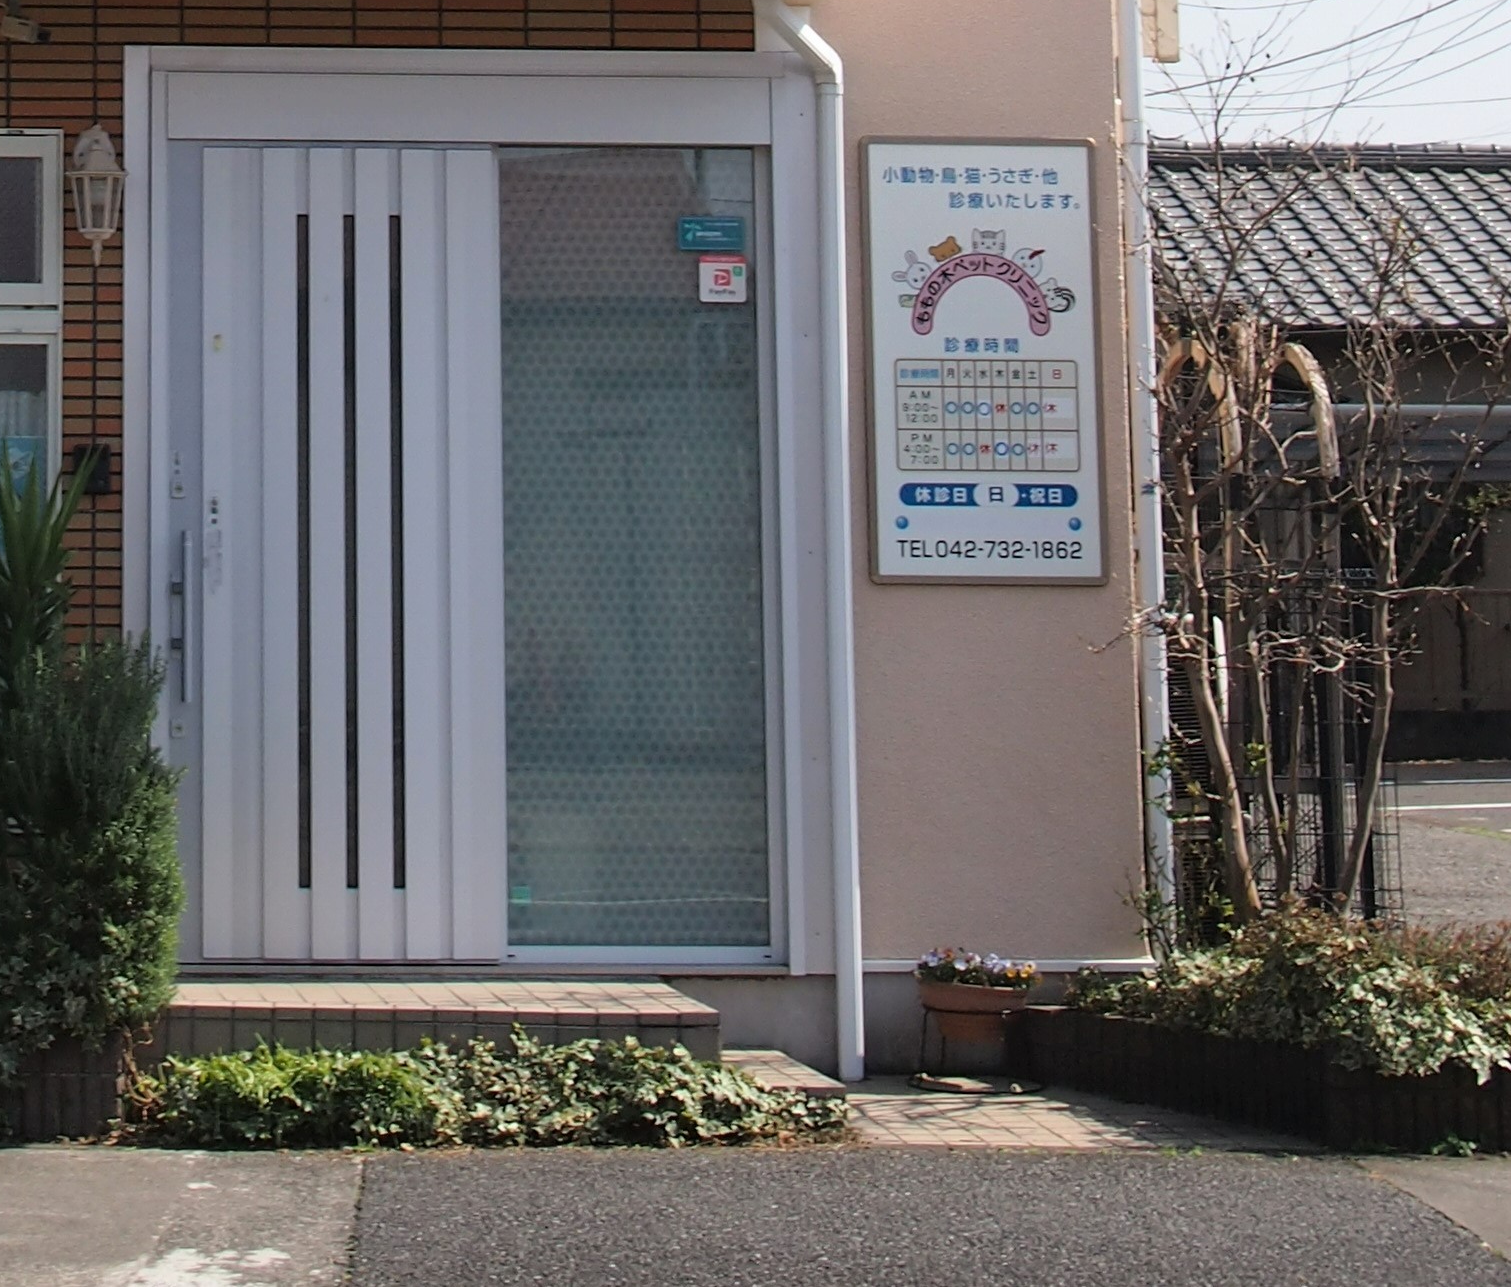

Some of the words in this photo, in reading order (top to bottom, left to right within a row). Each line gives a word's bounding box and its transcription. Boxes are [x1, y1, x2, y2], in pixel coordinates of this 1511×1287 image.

[948, 191, 1081, 209] 診療いたします。
[917, 256, 1048, 324] ももの木ペットクリニック
[944, 336, 1019, 353] 診療時間
[947, 368, 955, 379] 月
[1012, 369, 1021, 379] 金
[1028, 370, 1037, 379] 土
[1053, 369, 1062, 379] 日
[989, 486, 1004, 503] 日
